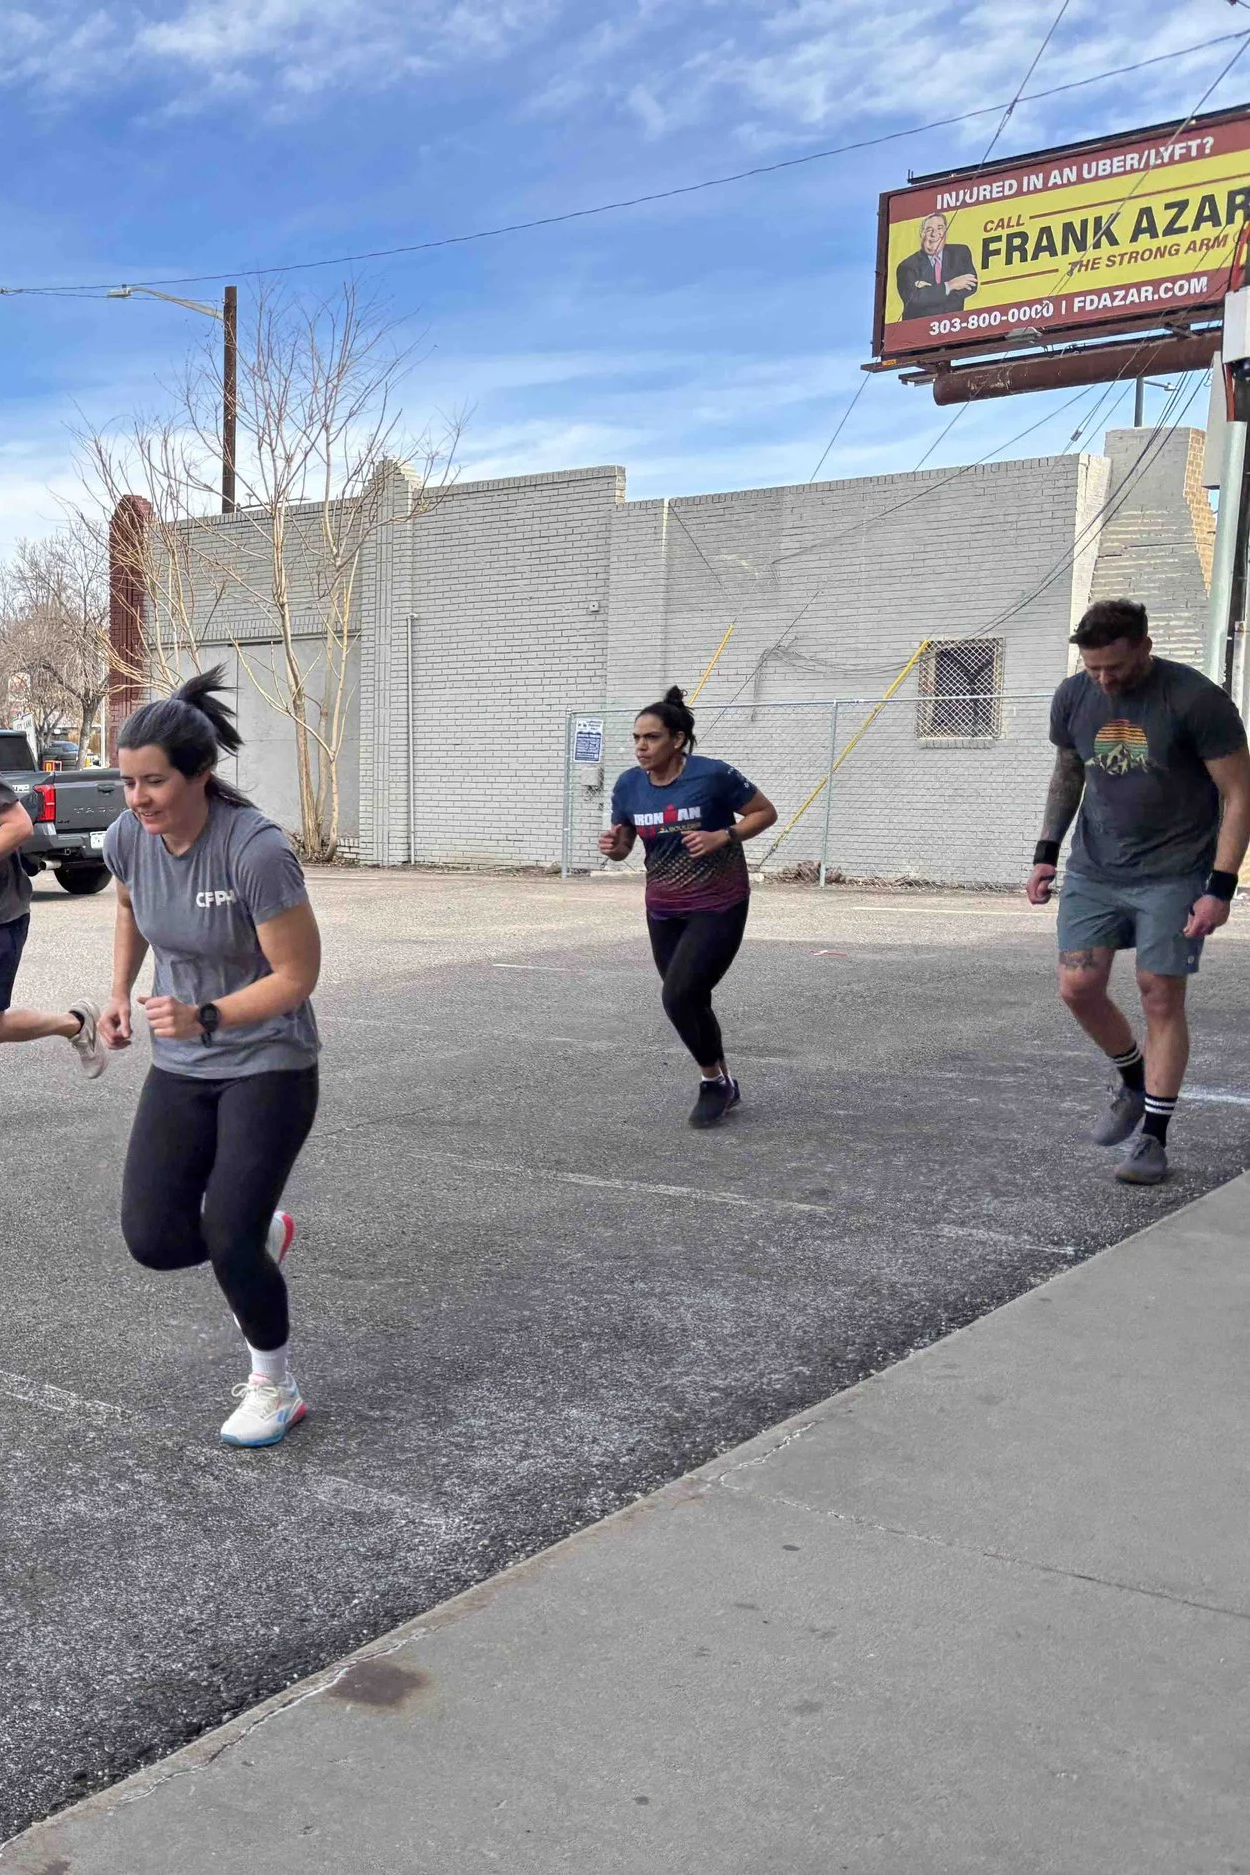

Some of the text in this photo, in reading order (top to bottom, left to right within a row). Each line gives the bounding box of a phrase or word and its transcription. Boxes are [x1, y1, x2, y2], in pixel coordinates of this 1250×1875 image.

[936, 136, 1214, 210] INJURED IN AN UBER/LYFT?
[981, 185, 1250, 270] FRANK AZAR
[983, 214, 1025, 233] CALL
[1068, 233, 1229, 273] THE STRONG ARM
[929, 276, 1208, 336] 303-800-0000 FDAZAR.COM
